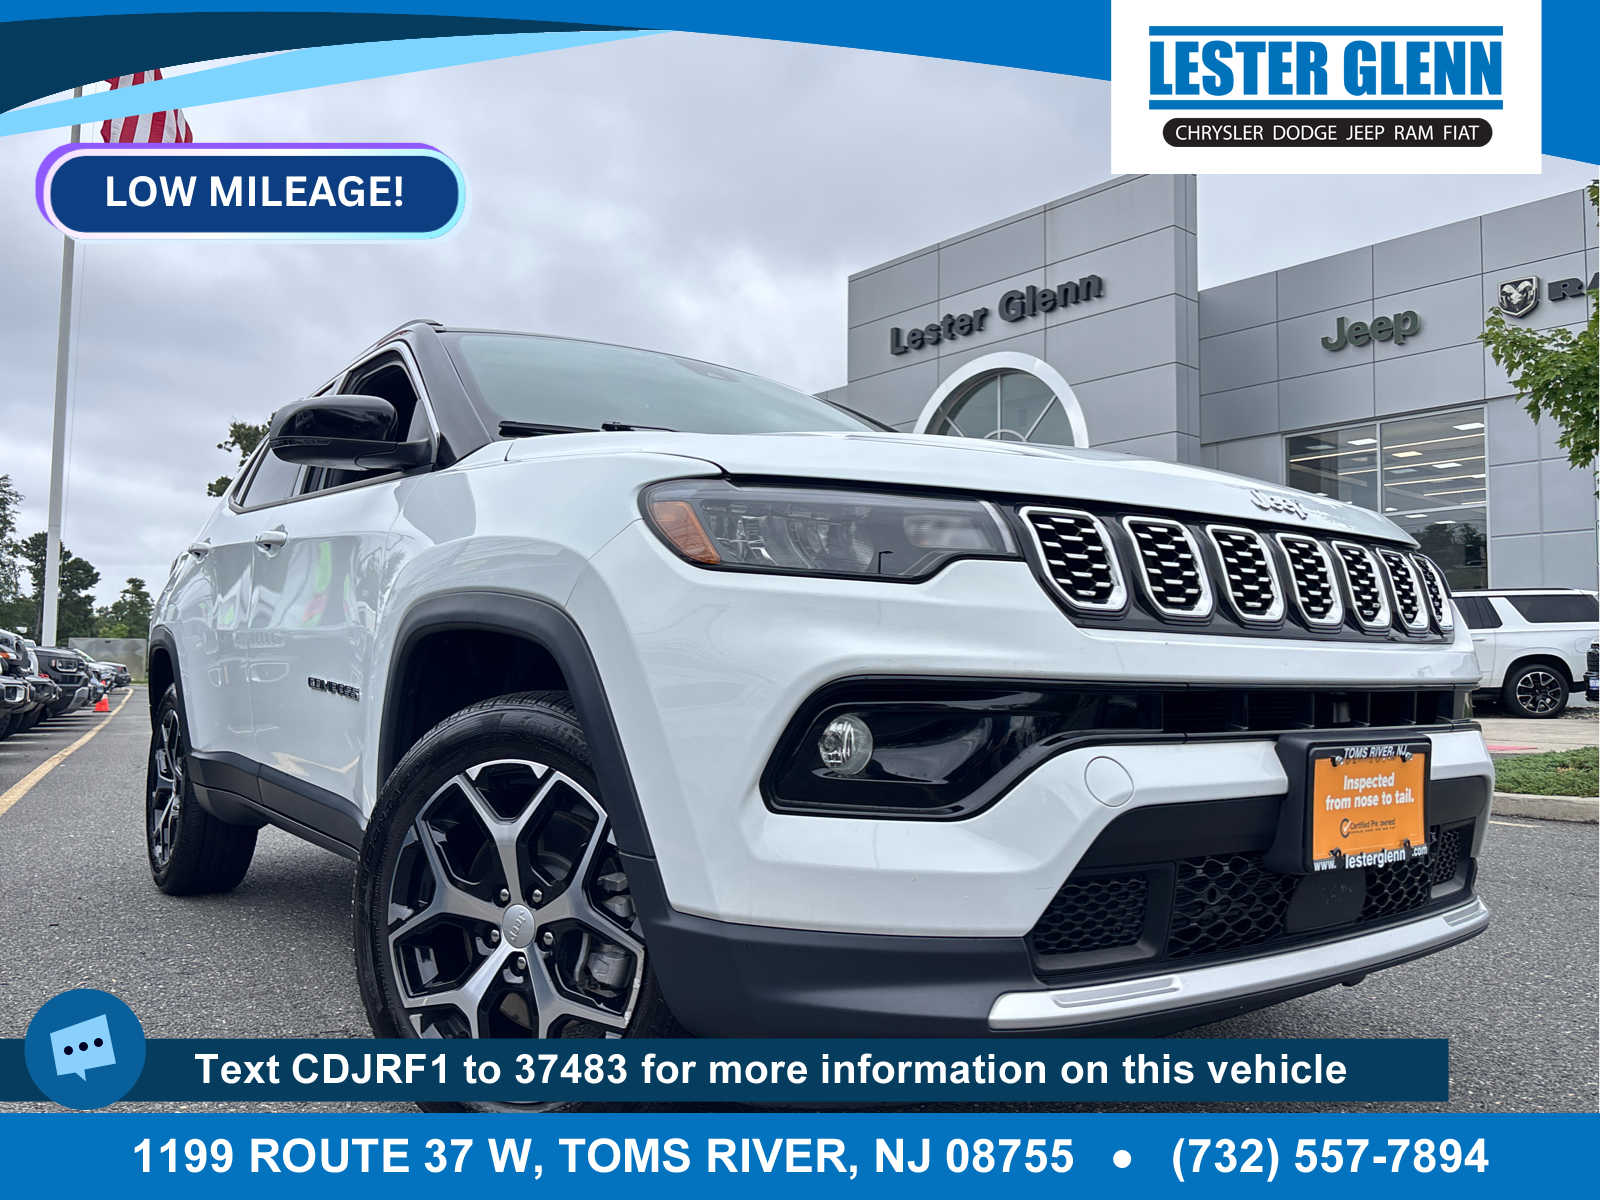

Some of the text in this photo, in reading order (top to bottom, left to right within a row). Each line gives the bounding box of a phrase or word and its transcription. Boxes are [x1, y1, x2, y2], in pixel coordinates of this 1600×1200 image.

[890, 274, 1104, 356] Lester Glenn
[1320, 310, 1420, 352] Jeep
[1249, 488, 1308, 520] Jeep
[1344, 746, 1368, 758] TOMS
[1396, 744, 1408, 756] NJ
[1343, 771, 1396, 793] Inspected
[1325, 788, 1415, 811] from nose to tail.
[1313, 845, 1428, 871] www. lesterglenn .com
